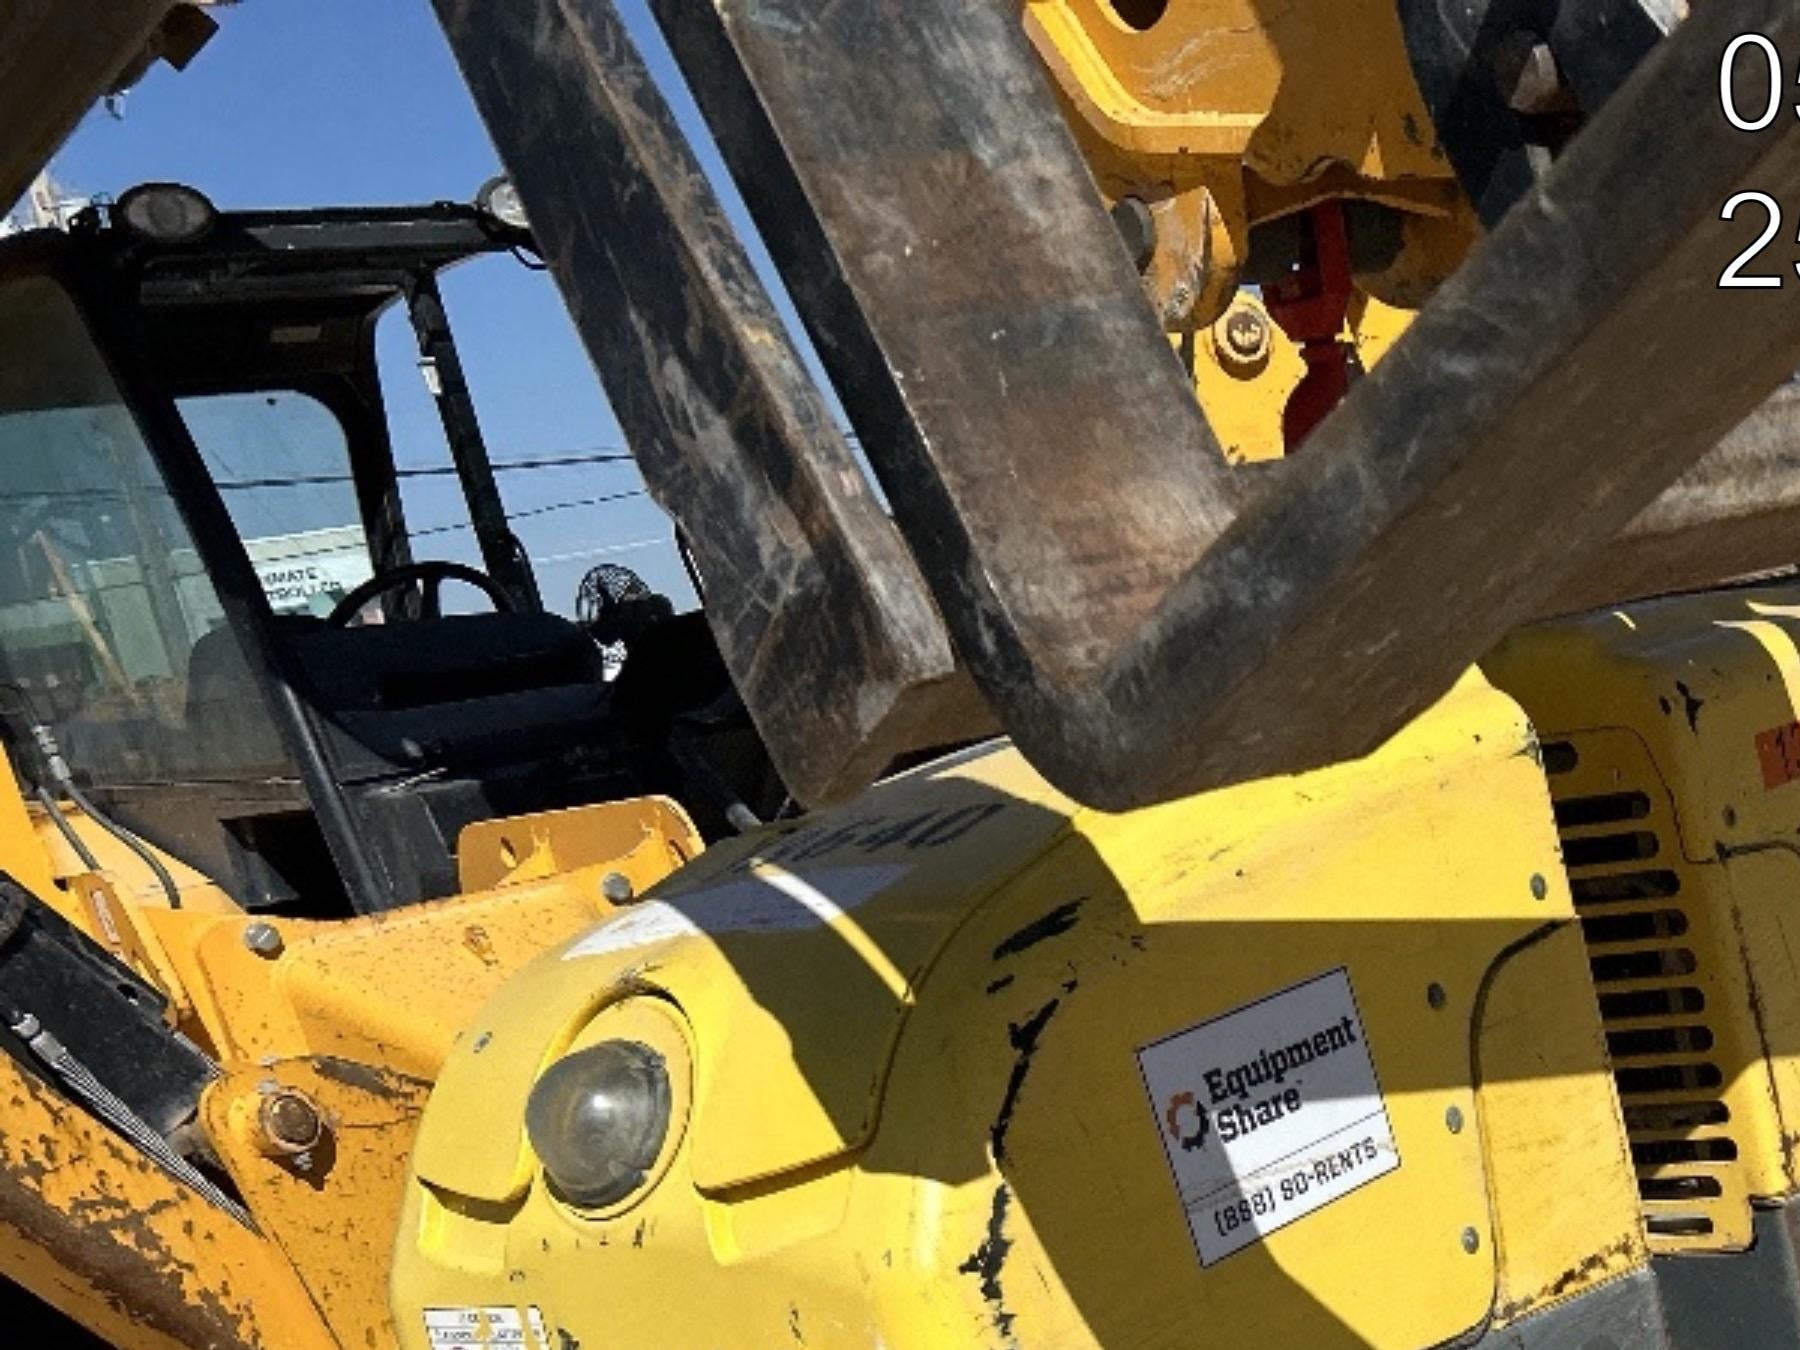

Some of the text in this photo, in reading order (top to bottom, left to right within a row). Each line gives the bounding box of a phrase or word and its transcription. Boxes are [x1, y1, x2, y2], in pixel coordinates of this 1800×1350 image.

[1202, 1016, 1358, 1105] Equipment
[1214, 1087, 1303, 1144] Share
[1213, 1184, 1276, 1237] (888)
